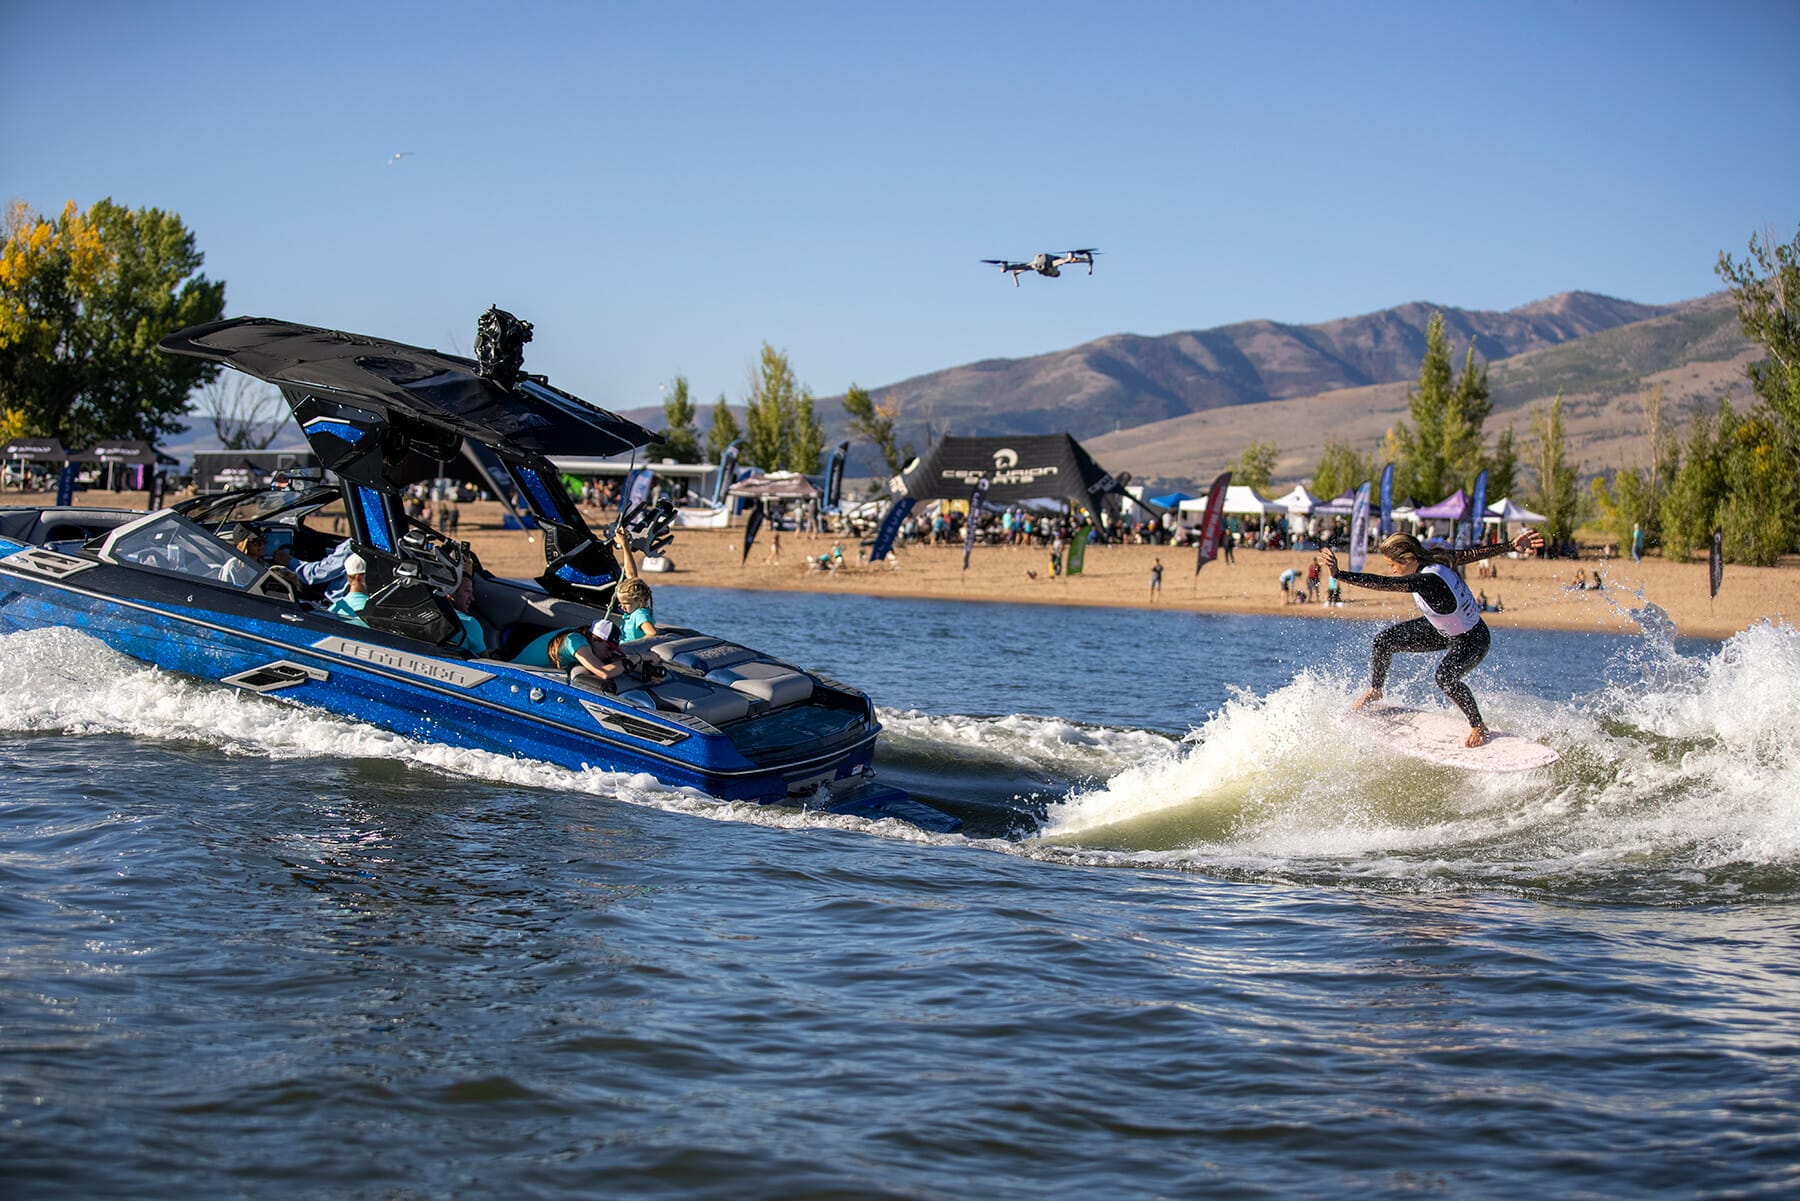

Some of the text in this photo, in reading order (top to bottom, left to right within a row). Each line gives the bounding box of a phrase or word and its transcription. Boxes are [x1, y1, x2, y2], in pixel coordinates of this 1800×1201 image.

[942, 466, 1058, 478] CENURION
[964, 475, 1035, 485] BATS
[340, 643, 465, 684] CENTURION
